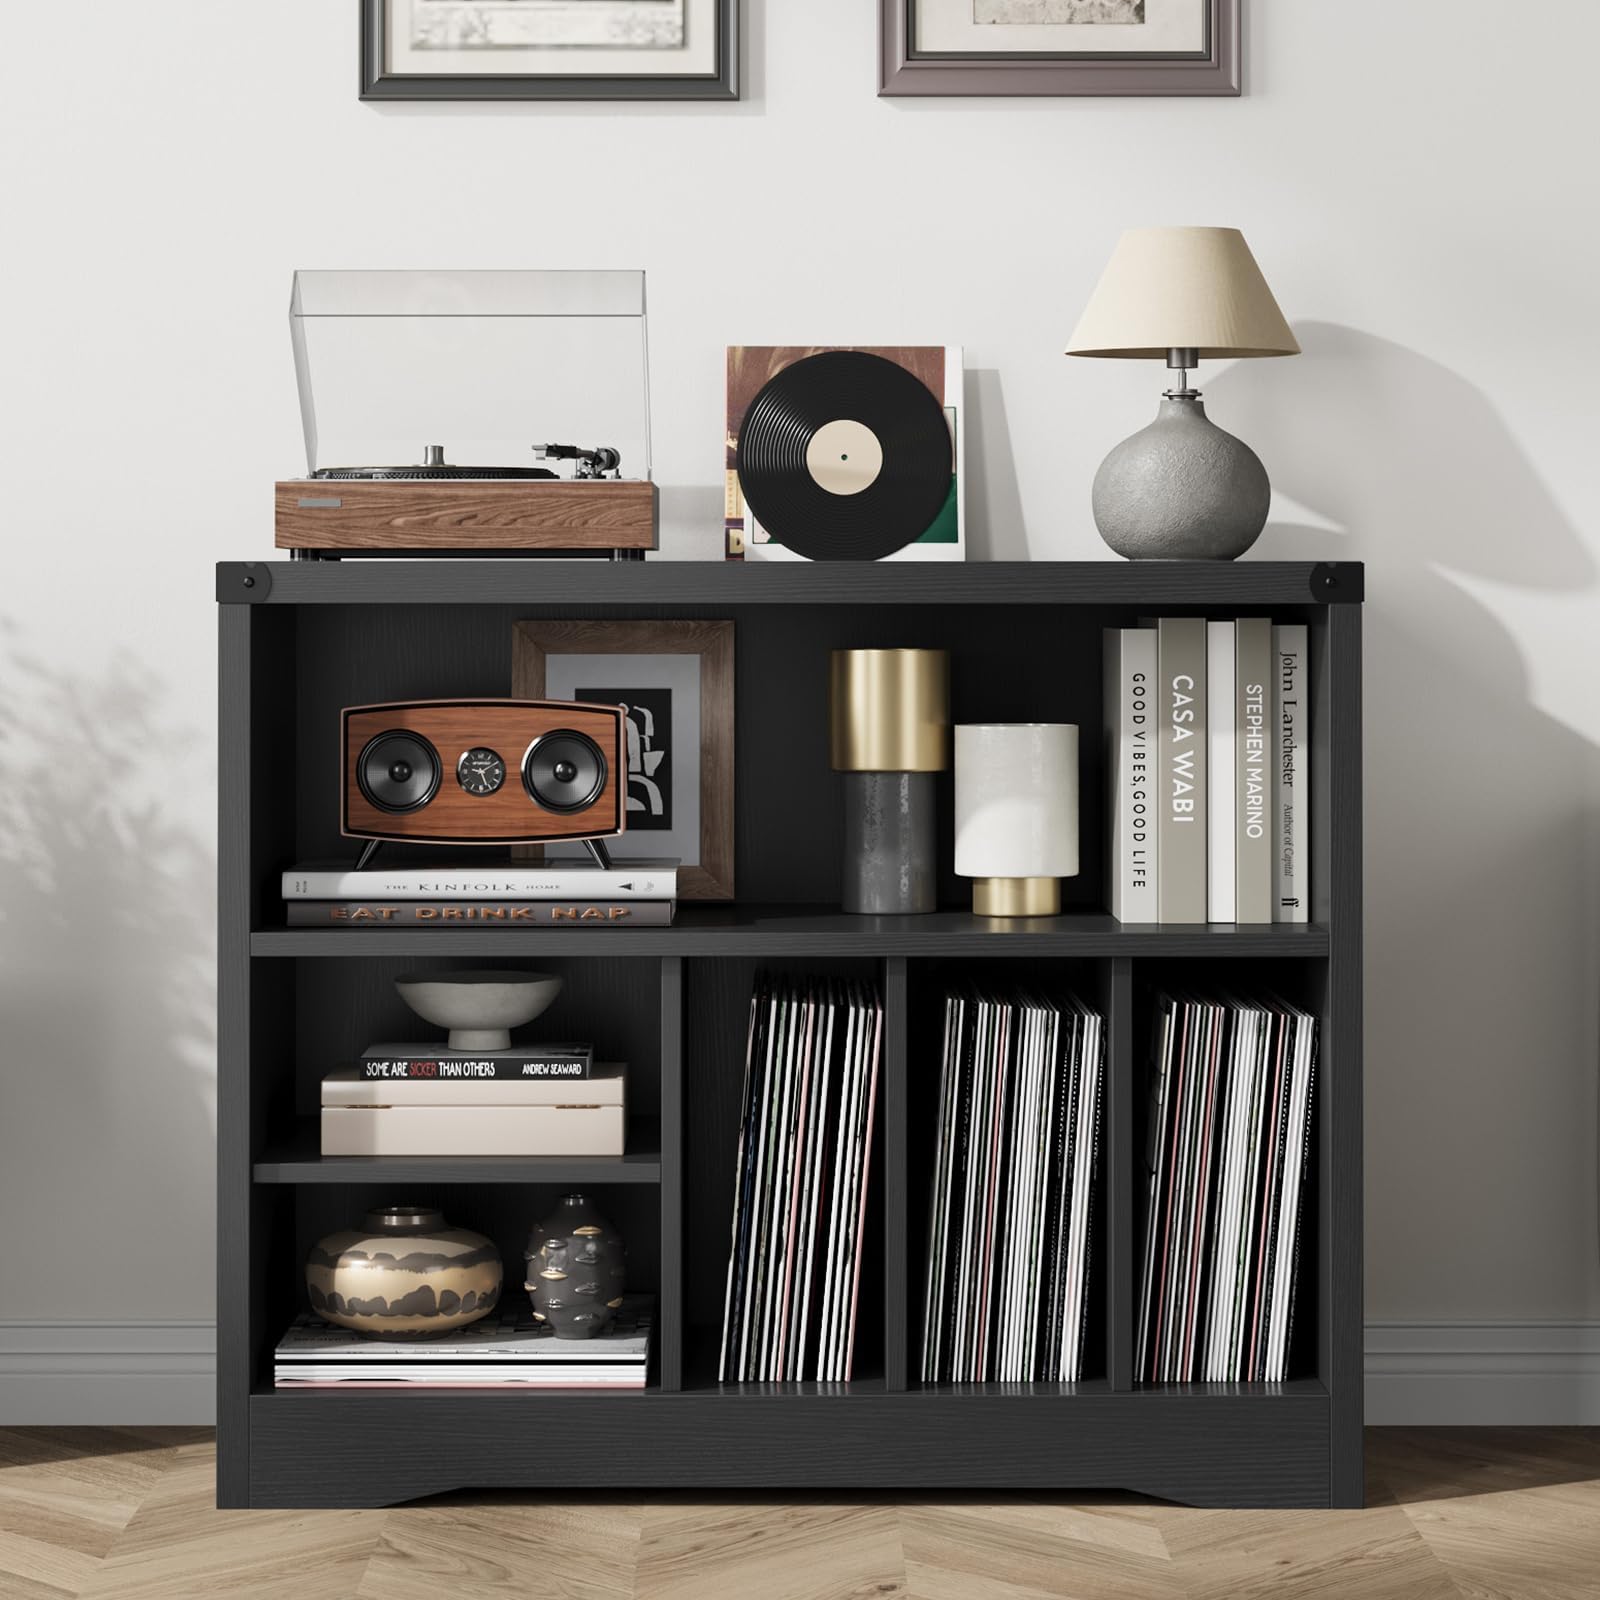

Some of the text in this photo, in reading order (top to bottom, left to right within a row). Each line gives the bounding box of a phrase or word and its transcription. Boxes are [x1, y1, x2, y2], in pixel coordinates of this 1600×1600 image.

[1133, 673, 1146, 725] GOOD
[1280, 652, 1297, 787] John Lanchester
[1172, 675, 1194, 822] CASA WABI
[1246, 684, 1263, 839] STEPHEN MARINO
[1283, 803, 1294, 835] Author
[1283, 837, 1294, 846] of
[1133, 850, 1146, 888] LIFE
[419, 883, 517, 891] KINFOLK
[330, 907, 632, 920] EAT DRINK NAP
[366, 1062, 495, 1076] SOME ARE SICKER THAN OTHERS
[522, 1063, 582, 1075] ANDREW SEAWARD
